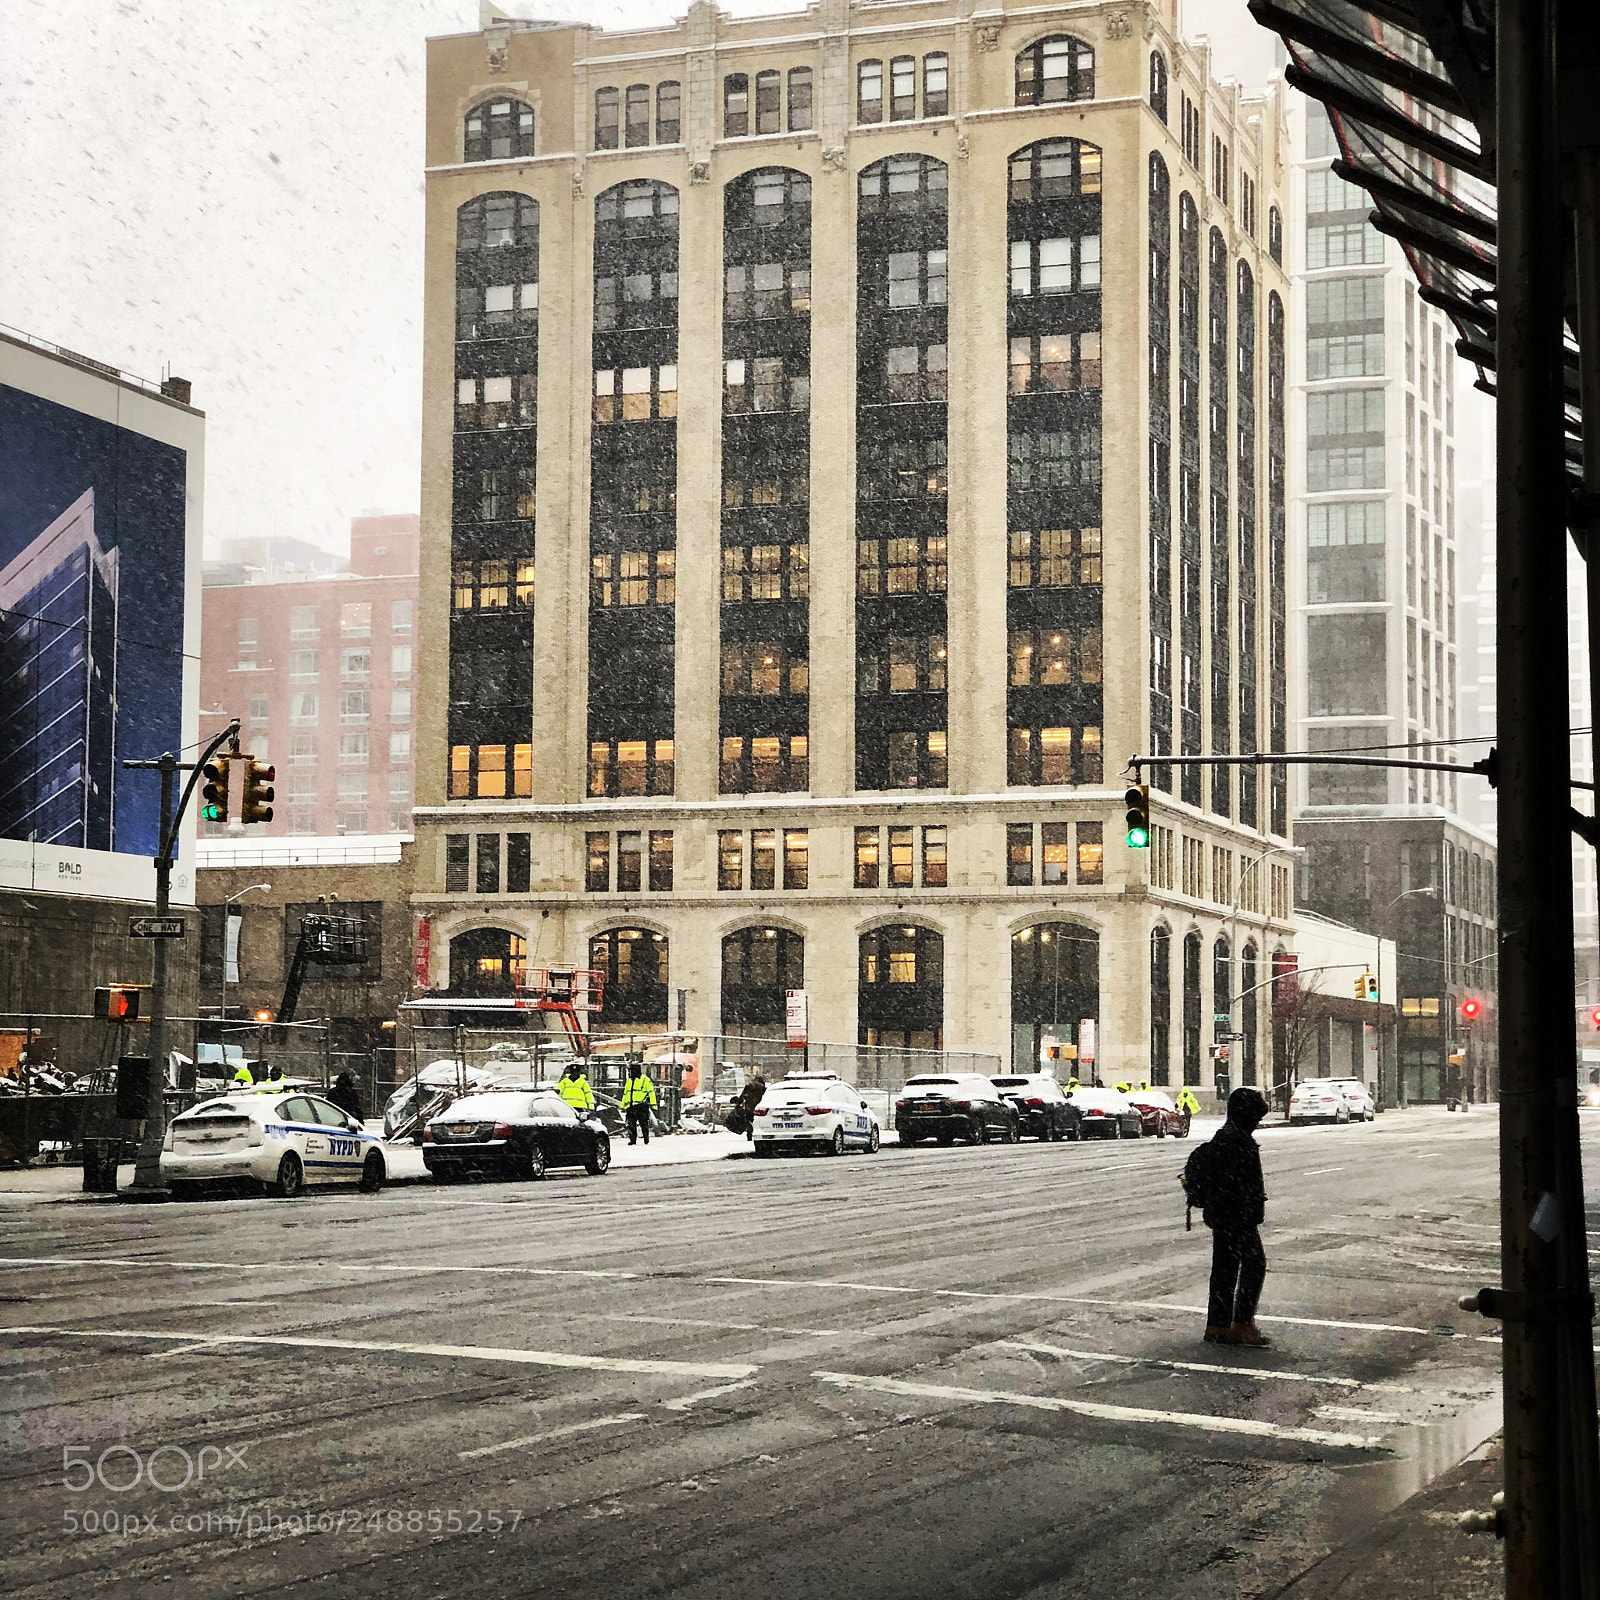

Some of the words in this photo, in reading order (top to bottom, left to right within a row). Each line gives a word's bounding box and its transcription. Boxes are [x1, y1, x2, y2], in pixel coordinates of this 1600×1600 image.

[137, 923, 153, 932] ONE
[160, 923, 178, 932] WAY
[328, 1138, 354, 1156] NYPD
